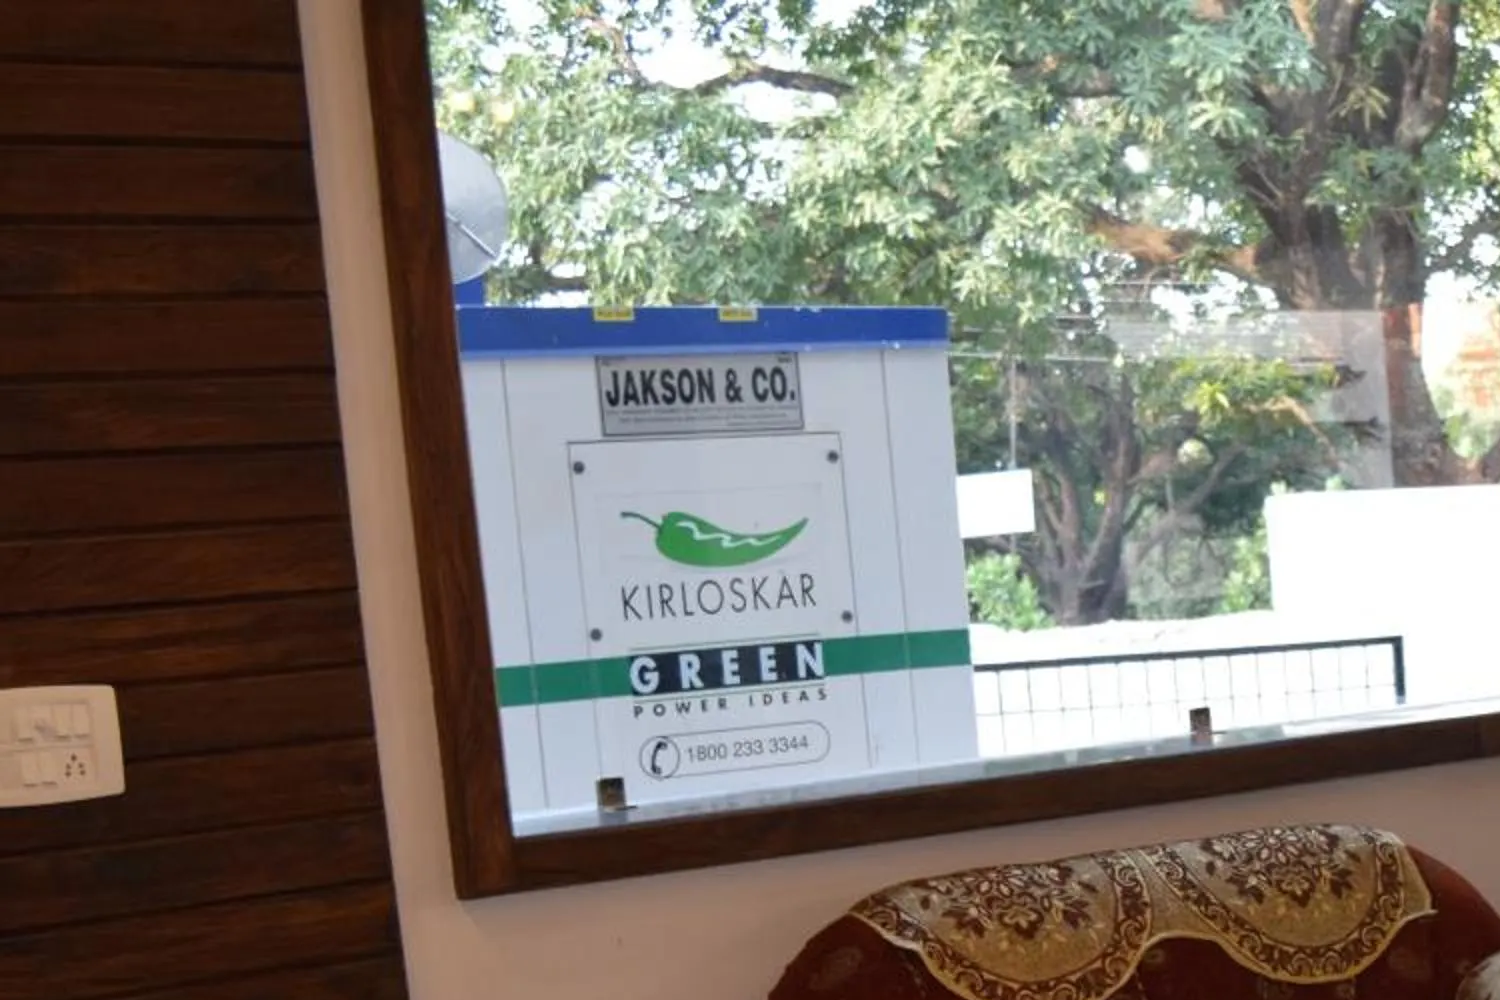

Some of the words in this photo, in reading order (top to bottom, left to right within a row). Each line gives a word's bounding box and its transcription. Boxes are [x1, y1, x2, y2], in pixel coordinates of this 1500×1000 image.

[605, 367, 716, 407] JAKSON
[724, 367, 743, 402] &
[752, 366, 796, 402] CO.
[621, 573, 817, 621] KIRLOSKAR
[629, 641, 825, 694] GREEN
[633, 697, 728, 719] POWER
[748, 688, 828, 707] IDEAS
[687, 744, 728, 762] 1800
[732, 739, 764, 758] 233
[769, 735, 809, 753] 3344
